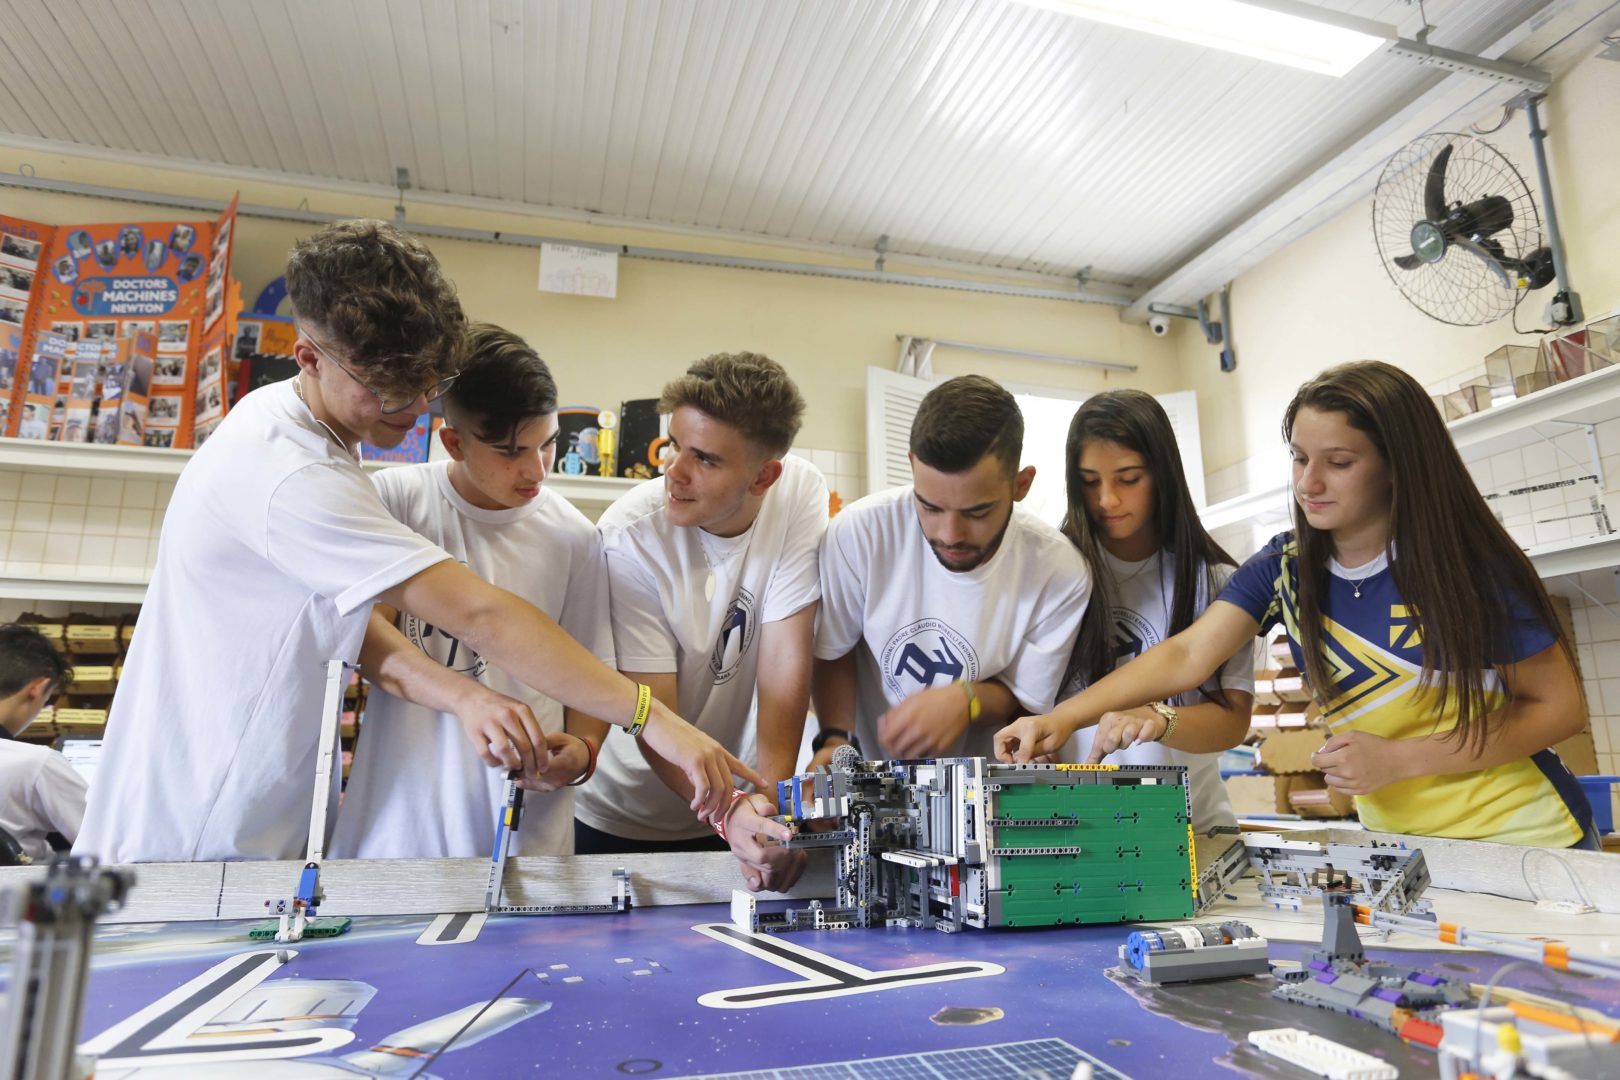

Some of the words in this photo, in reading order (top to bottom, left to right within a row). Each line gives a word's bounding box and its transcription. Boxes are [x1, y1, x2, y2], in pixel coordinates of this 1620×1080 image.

[112, 279, 168, 289] DOCTORS
[103, 290, 177, 302] MACHINES
[111, 303, 164, 314] NEWTON
[1135, 617, 1151, 636] ENSINO
[893, 630, 909, 645] PADRE
